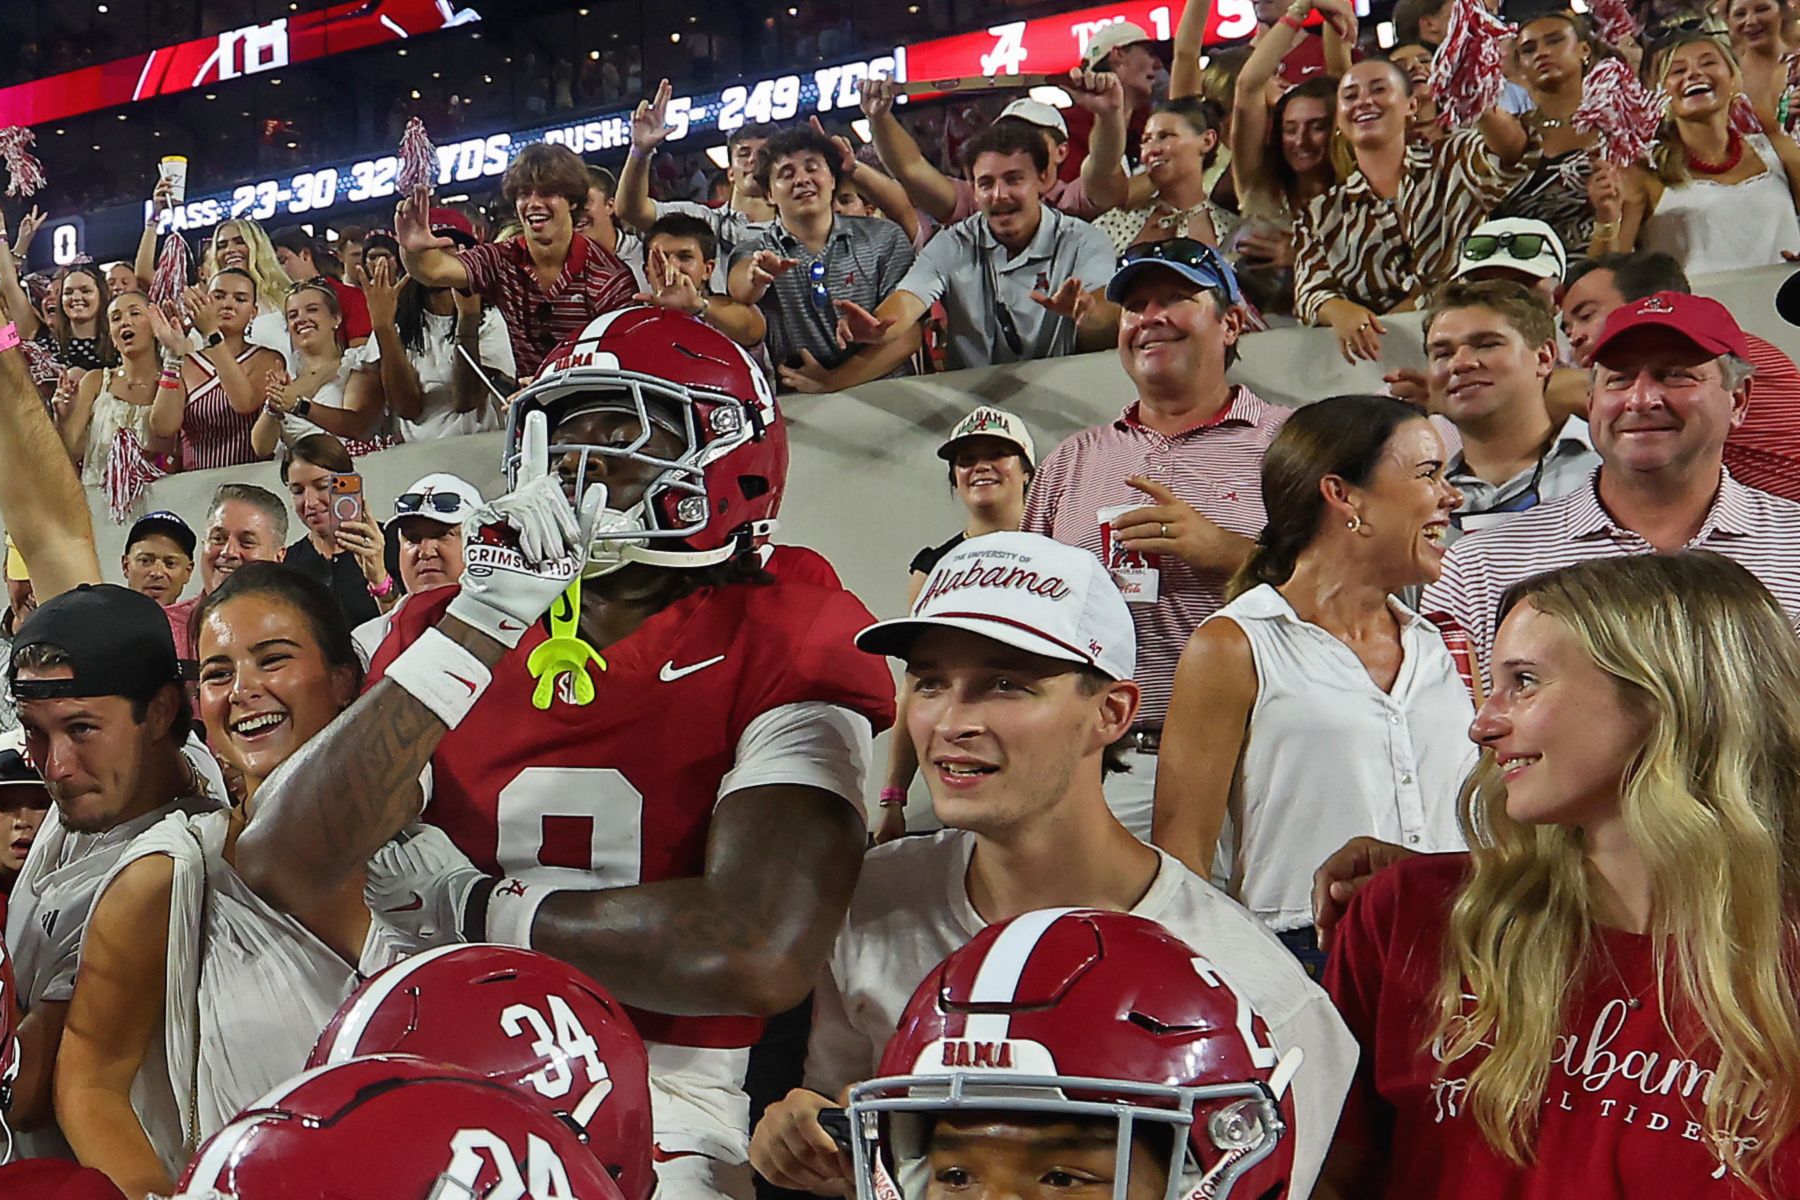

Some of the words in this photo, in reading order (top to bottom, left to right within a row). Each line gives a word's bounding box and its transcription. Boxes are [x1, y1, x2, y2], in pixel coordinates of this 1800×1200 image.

[347, 156, 405, 204] 32
[435, 133, 512, 185] YDS
[718, 76, 800, 131] 249
[53, 224, 77, 266] 0
[967, 550, 1019, 560] UNIVERSITY
[1019, 555, 1033, 563] OF
[914, 558, 1071, 617] Alabama
[499, 994, 611, 1099] 34
[941, 1041, 1013, 1068] BAMA
[1599, 1098, 1705, 1142] TIDE
